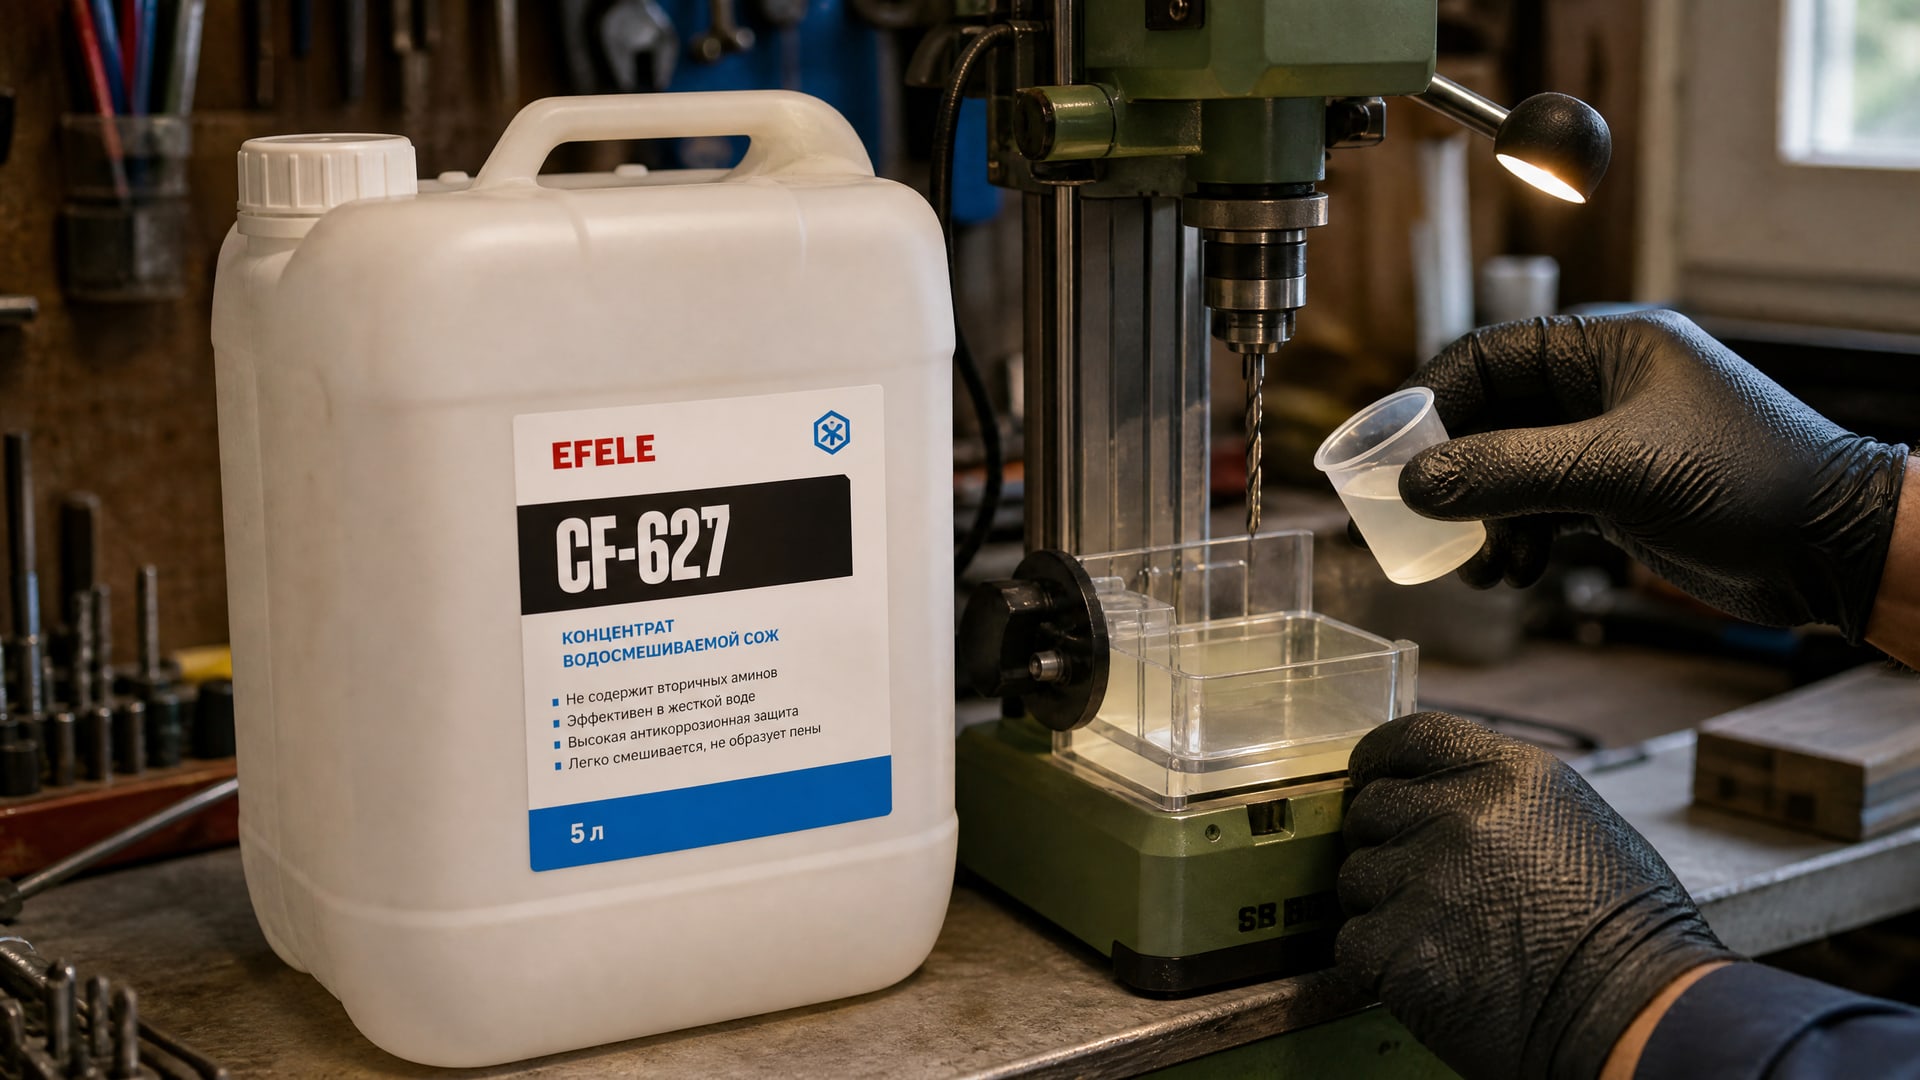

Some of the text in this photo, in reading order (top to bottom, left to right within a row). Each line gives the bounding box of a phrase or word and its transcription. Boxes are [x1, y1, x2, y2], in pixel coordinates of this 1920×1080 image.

[552, 434, 656, 470] EFELE
[555, 503, 731, 594] CF-627
[562, 619, 675, 645] КОНЦЕНТРАТ
[563, 628, 780, 668] ВОДОСМЕШИВАЕМОЙ СОЖ
[566, 668, 778, 706] Не содержит вторичных аминов
[567, 692, 756, 728] Эффективен в жесткой воде
[568, 707, 799, 748] Высокая антикоррозионная защита
[568, 724, 821, 770] Легко смешивается, не образует пены
[570, 822, 604, 843] 5 л
[1238, 902, 1277, 932] SB
